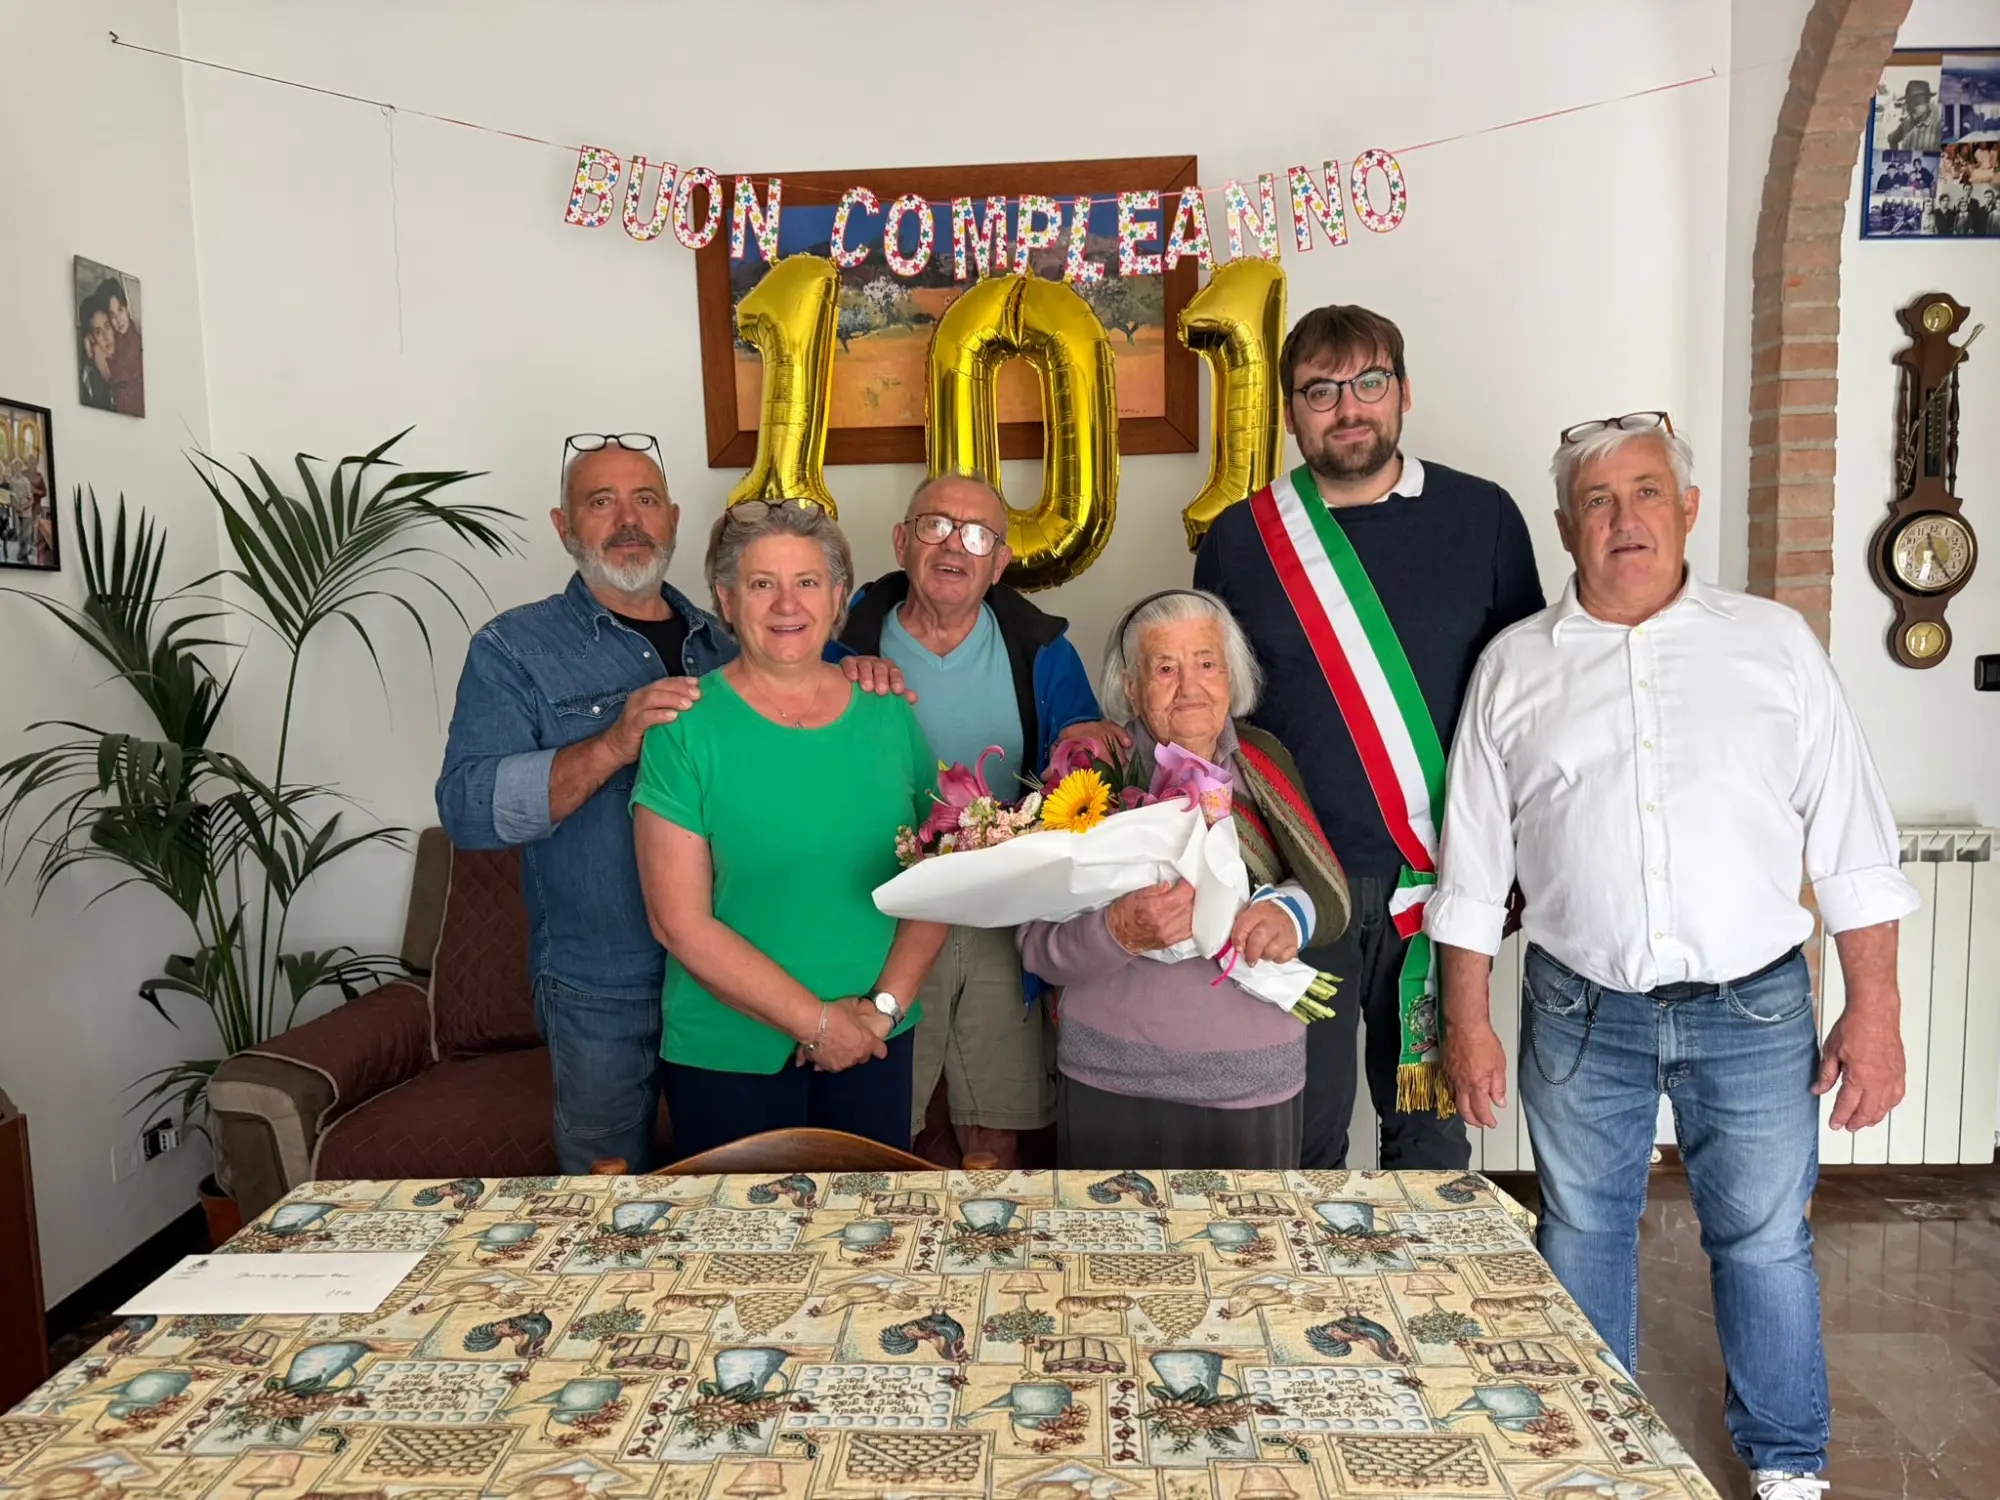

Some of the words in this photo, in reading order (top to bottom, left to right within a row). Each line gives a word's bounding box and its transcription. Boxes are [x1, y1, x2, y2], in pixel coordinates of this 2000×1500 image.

[564, 144, 783, 262] BUON
[829, 148, 1408, 283] COMPLEANNO
[726, 252, 1286, 590] 101
[1917, 527, 1925, 536] 11
